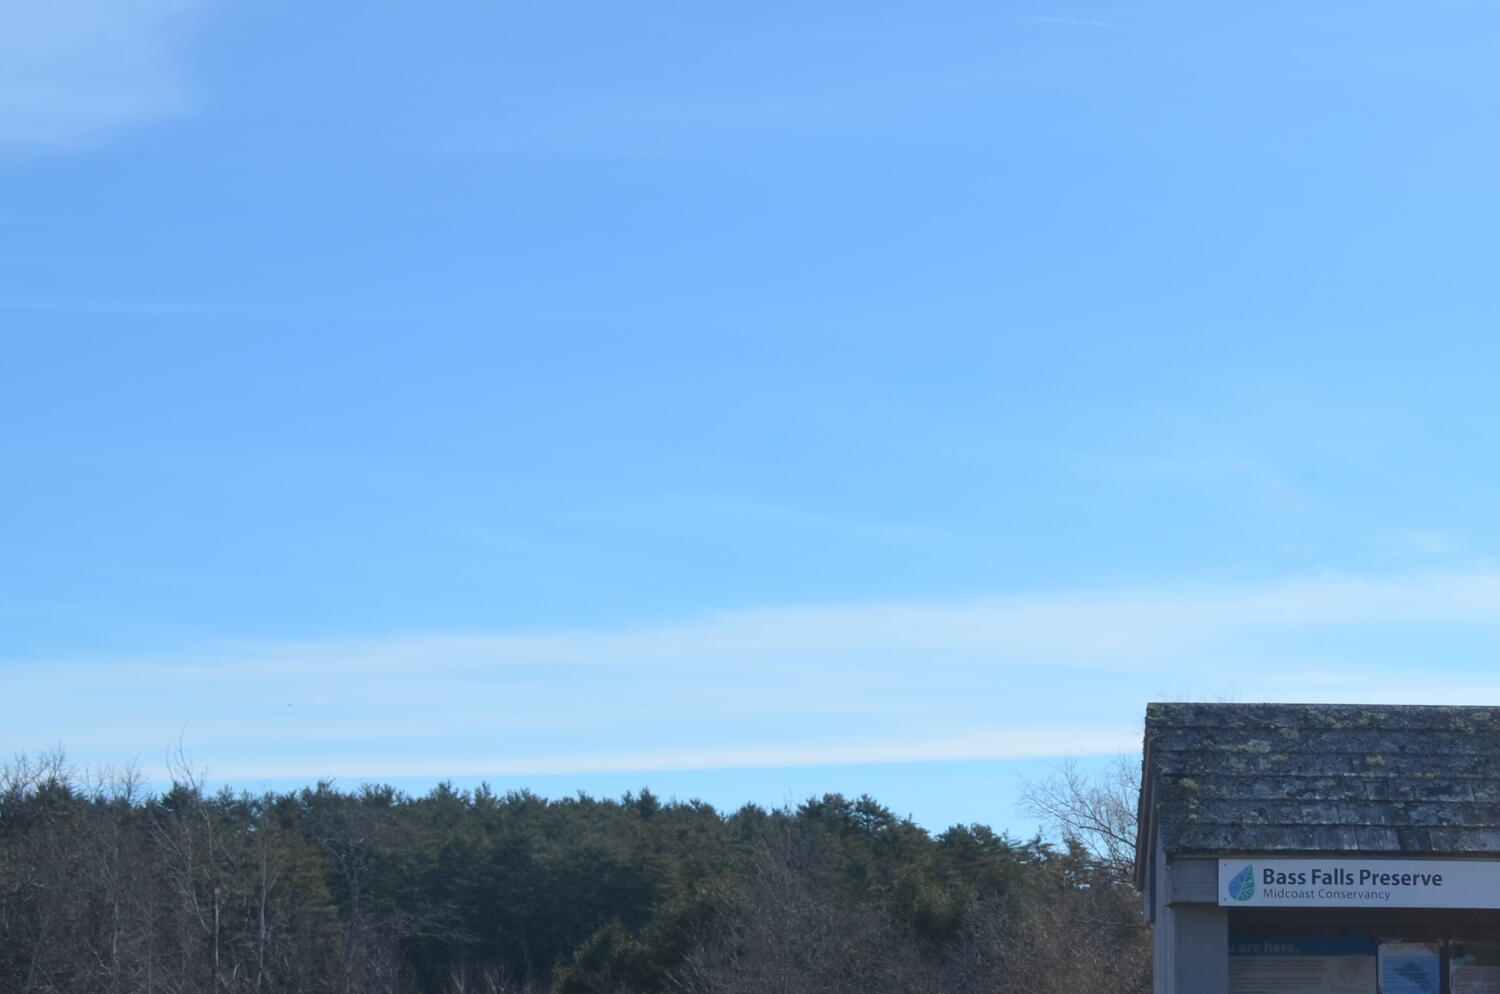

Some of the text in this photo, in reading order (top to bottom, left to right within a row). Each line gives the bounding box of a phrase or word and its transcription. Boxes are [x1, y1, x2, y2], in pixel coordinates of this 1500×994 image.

[1262, 868, 1442, 887] Bass Falls Preserve
[1263, 888, 1391, 901] Midcoast Conservancy
[1239, 943, 1261, 953] are
